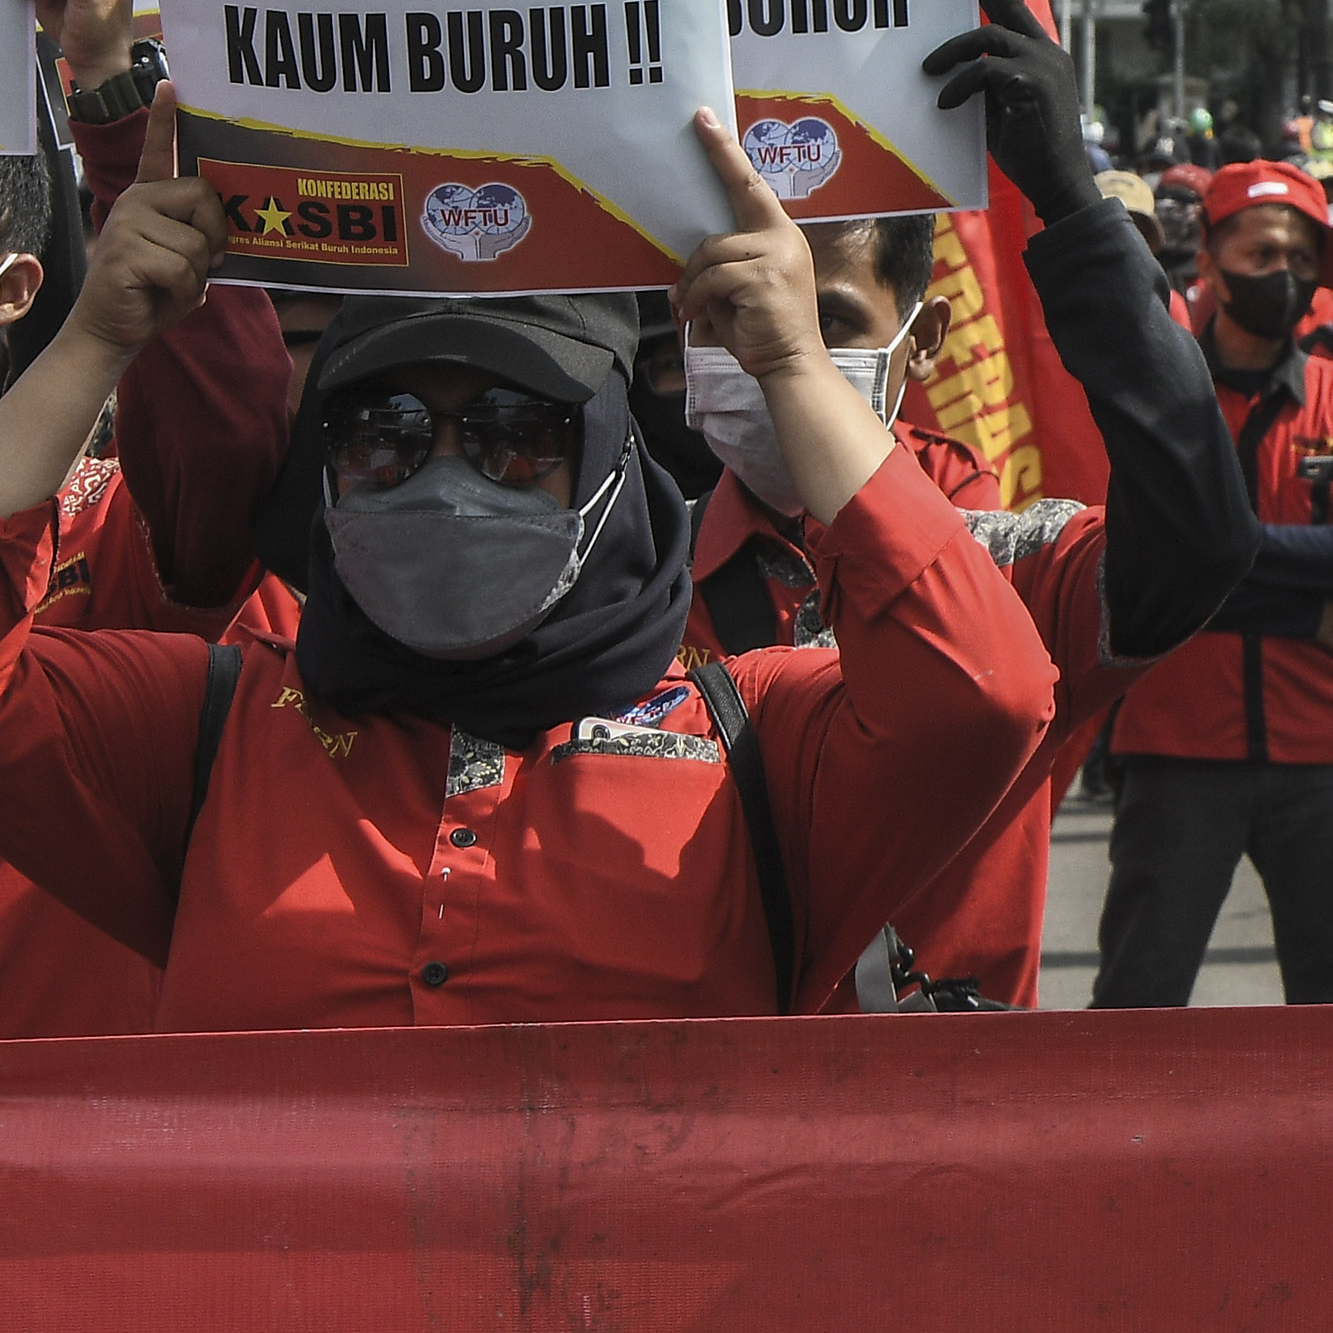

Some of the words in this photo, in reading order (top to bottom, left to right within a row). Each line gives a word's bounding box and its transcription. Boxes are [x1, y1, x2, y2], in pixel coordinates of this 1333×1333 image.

[223, 4, 392, 93] KAUM
[405, 3, 610, 94] BURUH
[624, 0, 663, 86] !!
[758, 144, 821, 164] WFTU
[297, 178, 394, 201] KONFEDERASI
[440, 208, 509, 228] WFTU
[252, 236, 283, 248] Aliansi
[286, 240, 319, 252] Serikat
[321, 243, 349, 255] Buruh
[351, 245, 398, 256] Indonesia
